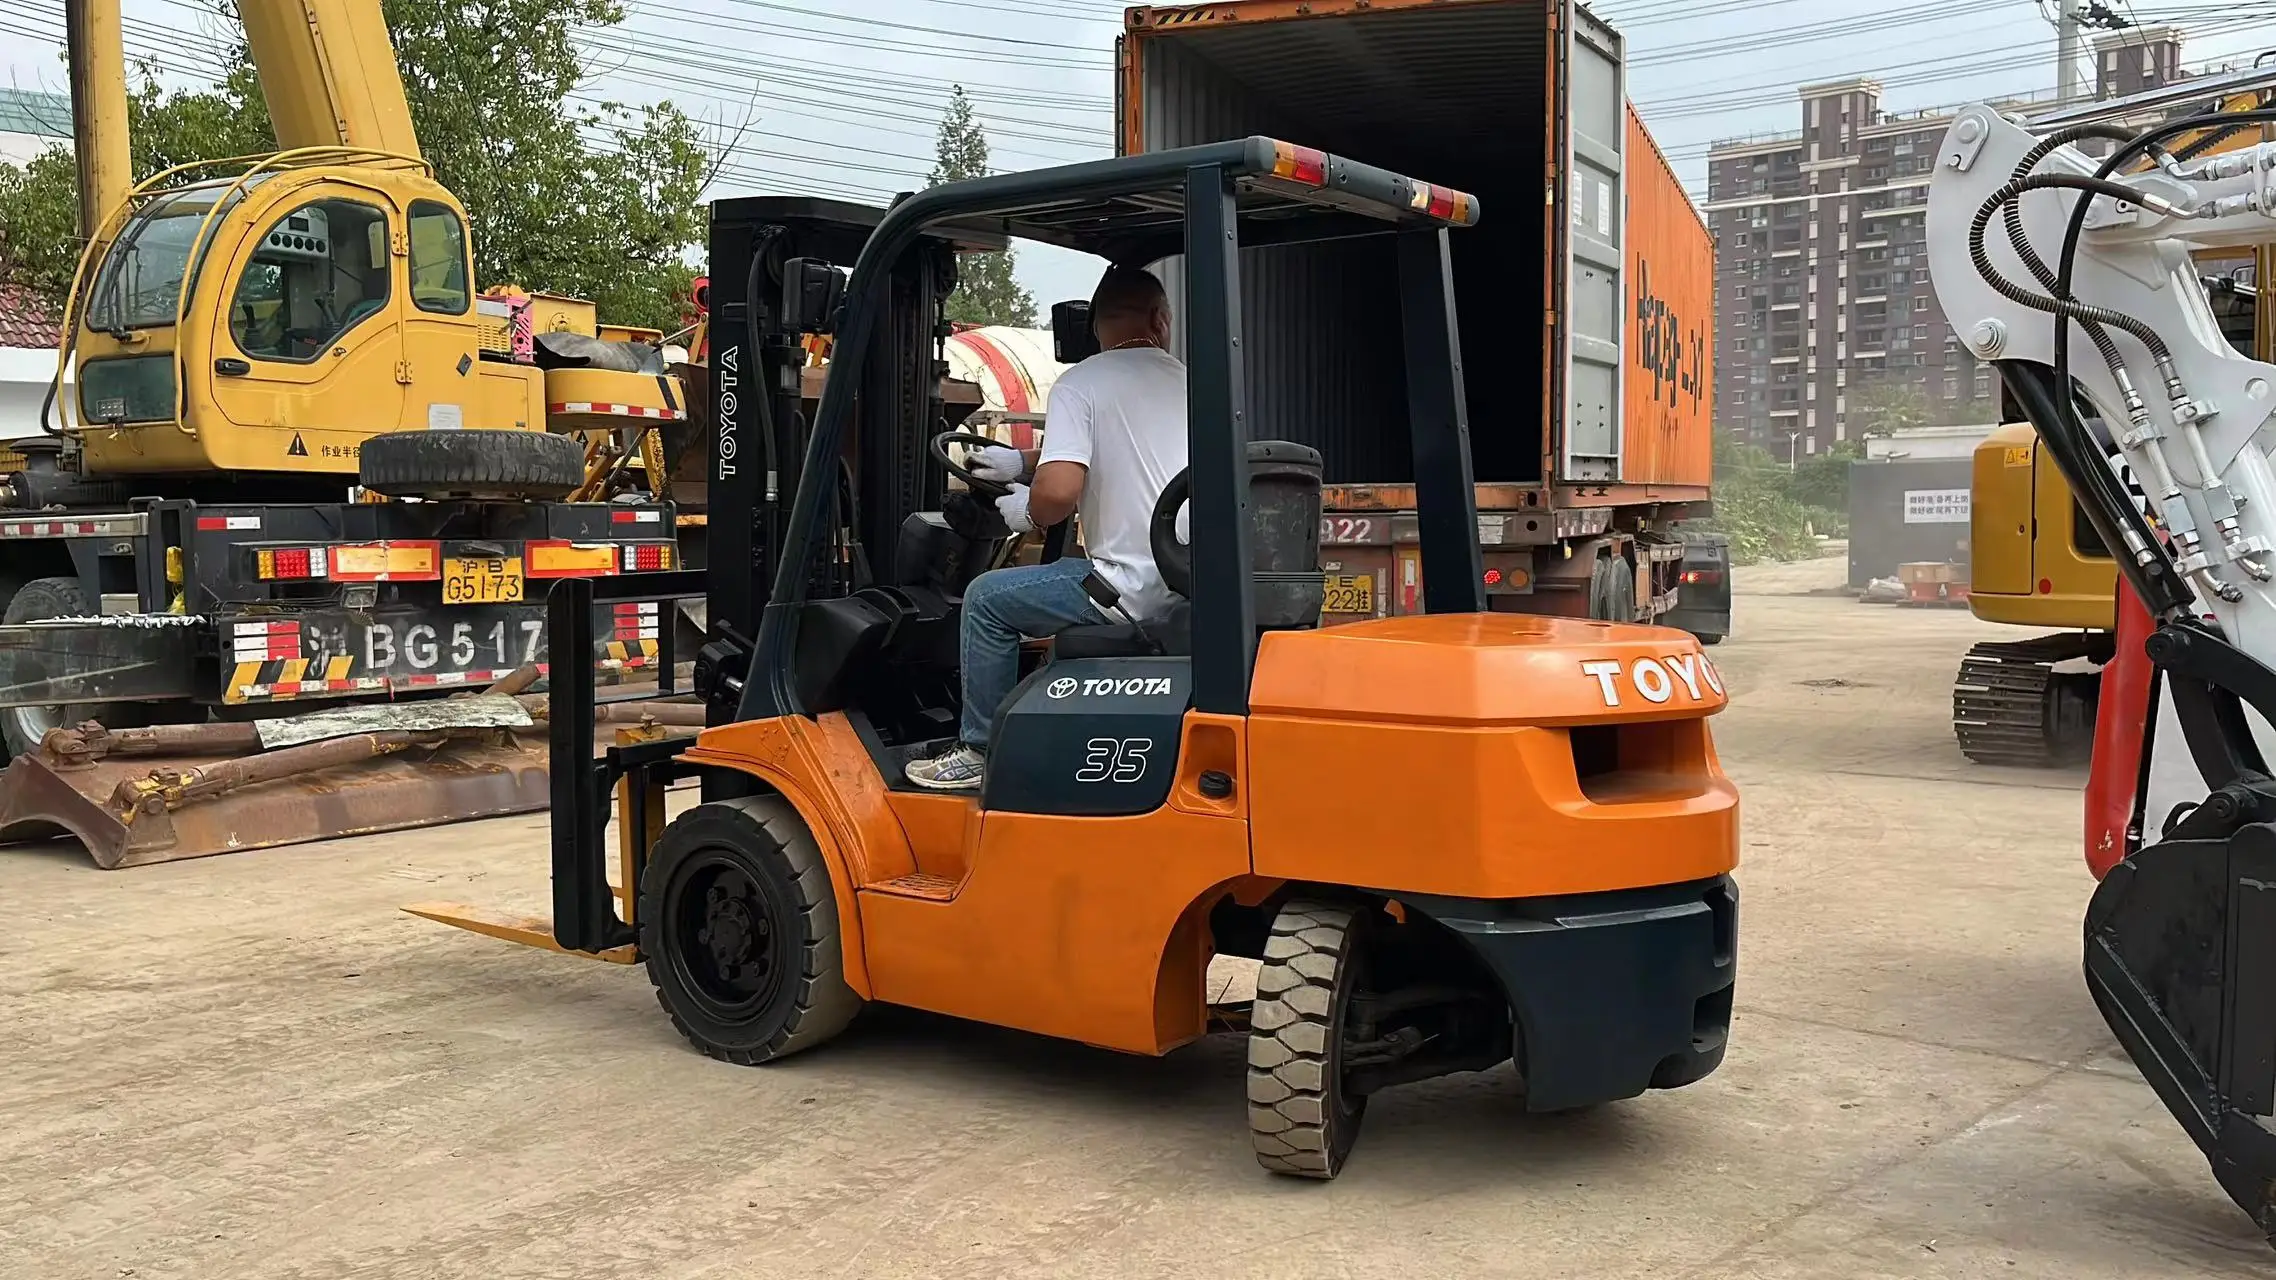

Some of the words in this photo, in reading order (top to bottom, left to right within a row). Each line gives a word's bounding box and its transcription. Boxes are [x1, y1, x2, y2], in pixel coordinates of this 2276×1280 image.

[719, 345, 738, 480] TOYOTA
[448, 575, 520, 600] G5173
[1322, 589, 1368, 609] 22挂
[1082, 678, 1172, 696] TOYOTA
[1075, 738, 1152, 782] 35
